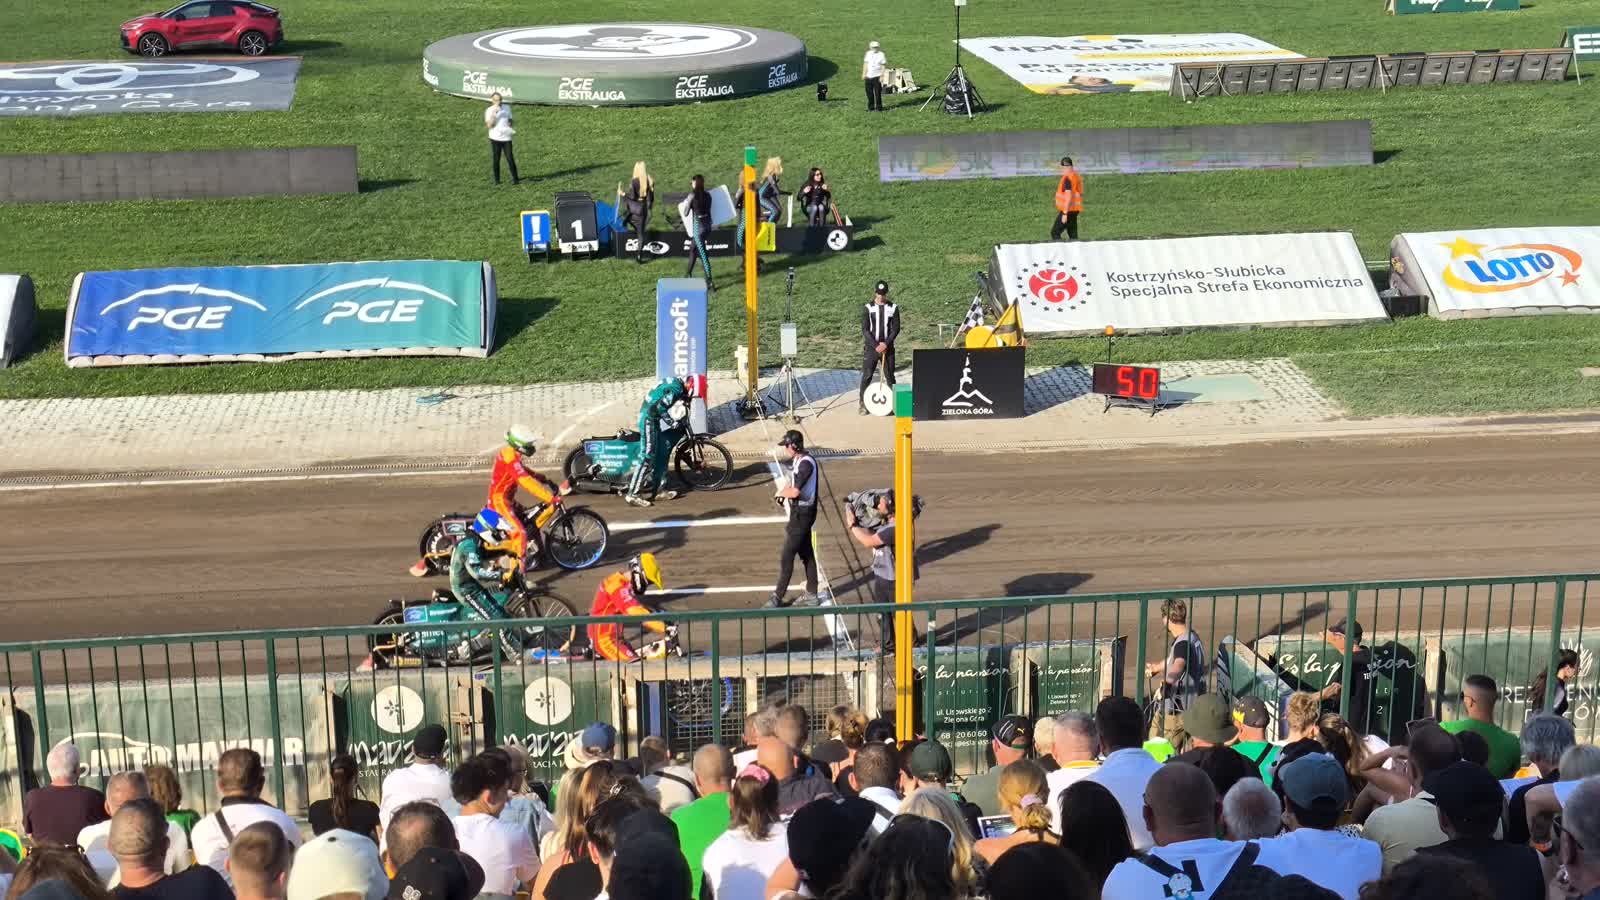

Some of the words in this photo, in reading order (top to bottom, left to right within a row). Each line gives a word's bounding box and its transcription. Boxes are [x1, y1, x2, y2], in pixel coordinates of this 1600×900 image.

[464, 70, 488, 84] PGE
[769, 64, 787, 78] PGE
[559, 78, 594, 90] PGE
[675, 76, 709, 88] PGE
[768, 73, 798, 88] EKSTRALIGA
[558, 89, 626, 101] EKSTRALIGA
[675, 85, 734, 99] EKSTRALIGA
[571, 220, 583, 240] 1
[1107, 264, 1286, 284] Kostrzyńsko-Słubicka
[1464, 252, 1555, 283] LOTTO
[1110, 284, 1194, 299] Specjalna
[1198, 280, 1249, 294] Strefa
[1254, 277, 1364, 291] Ekonomiczna
[128, 305, 233, 331] PGE
[323, 299, 424, 325] PGE
[670, 298, 689, 379] amsoft
[1117, 367, 1158, 398] 50
[871, 393, 887, 405] 3
[942, 408, 972, 416] ZIELONA
[973, 407, 994, 415] GÓRA
[943, 716, 969, 724] Zieona
